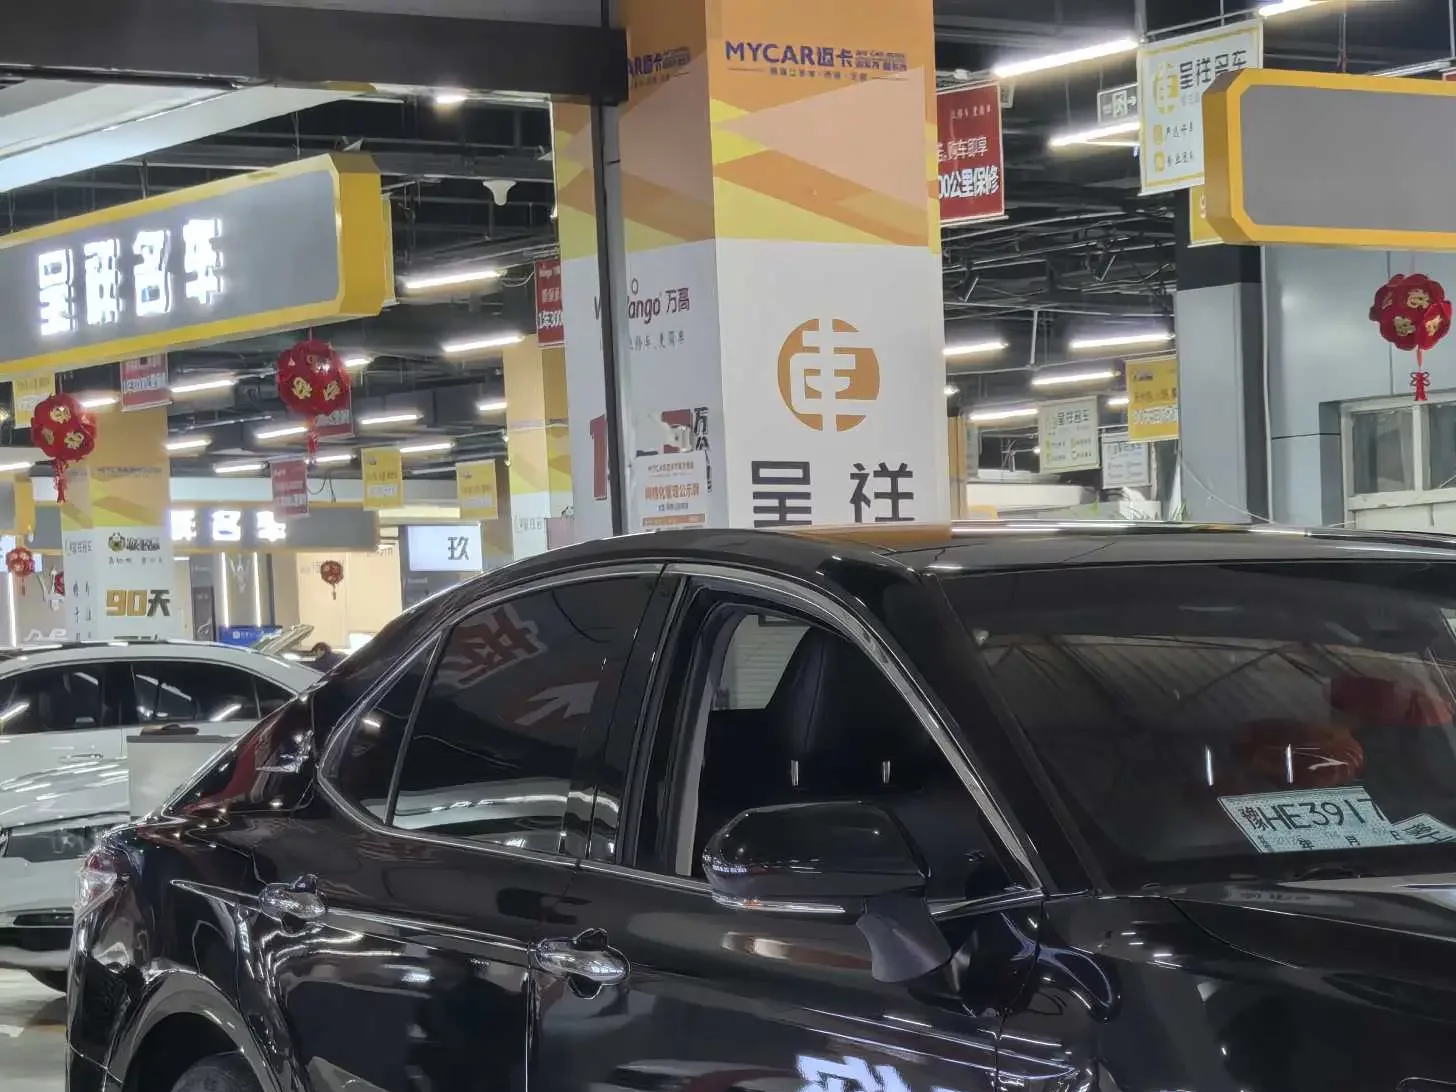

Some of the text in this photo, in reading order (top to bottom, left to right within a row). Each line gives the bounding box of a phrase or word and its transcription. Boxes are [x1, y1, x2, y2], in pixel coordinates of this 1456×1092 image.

[38, 217, 223, 336] 呈祥名车
[665, 287, 690, 313] 万高
[751, 460, 915, 529] 呈祥
[106, 589, 171, 617] 90天
